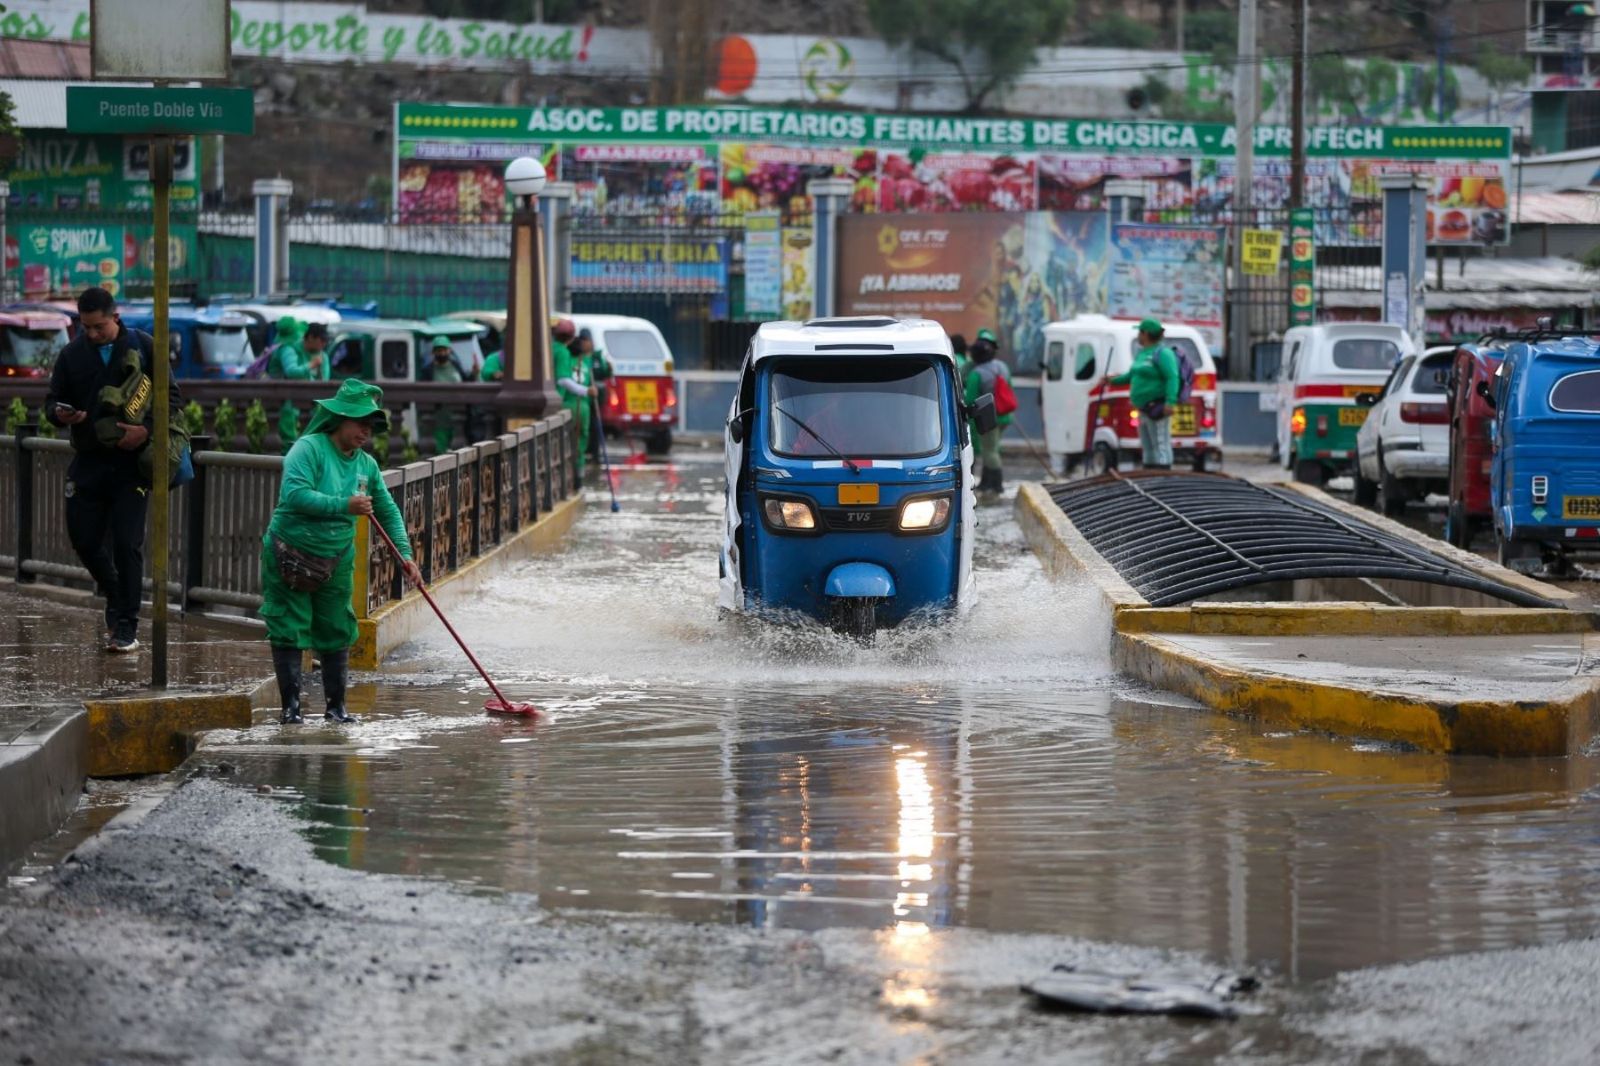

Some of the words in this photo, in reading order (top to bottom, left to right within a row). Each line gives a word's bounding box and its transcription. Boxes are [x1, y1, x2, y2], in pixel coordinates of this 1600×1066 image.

[384, 27, 404, 62] y
[417, 20, 454, 55] la
[100, 101, 149, 117] Puente
[153, 102, 194, 118] Doble
[528, 108, 613, 132] ASOC.
[621, 111, 658, 132] DE
[665, 110, 867, 139] PROPIETARIOS
[873, 118, 1026, 144] FERIANTES
[1033, 122, 1070, 145] DE
[1076, 124, 1198, 148] CHOSICA
[51, 227, 107, 254] SPINOZA
[859, 273, 885, 295] ¡YA
[886, 272, 961, 293] ABRIMOS!
[847, 512, 871, 522] TVS
